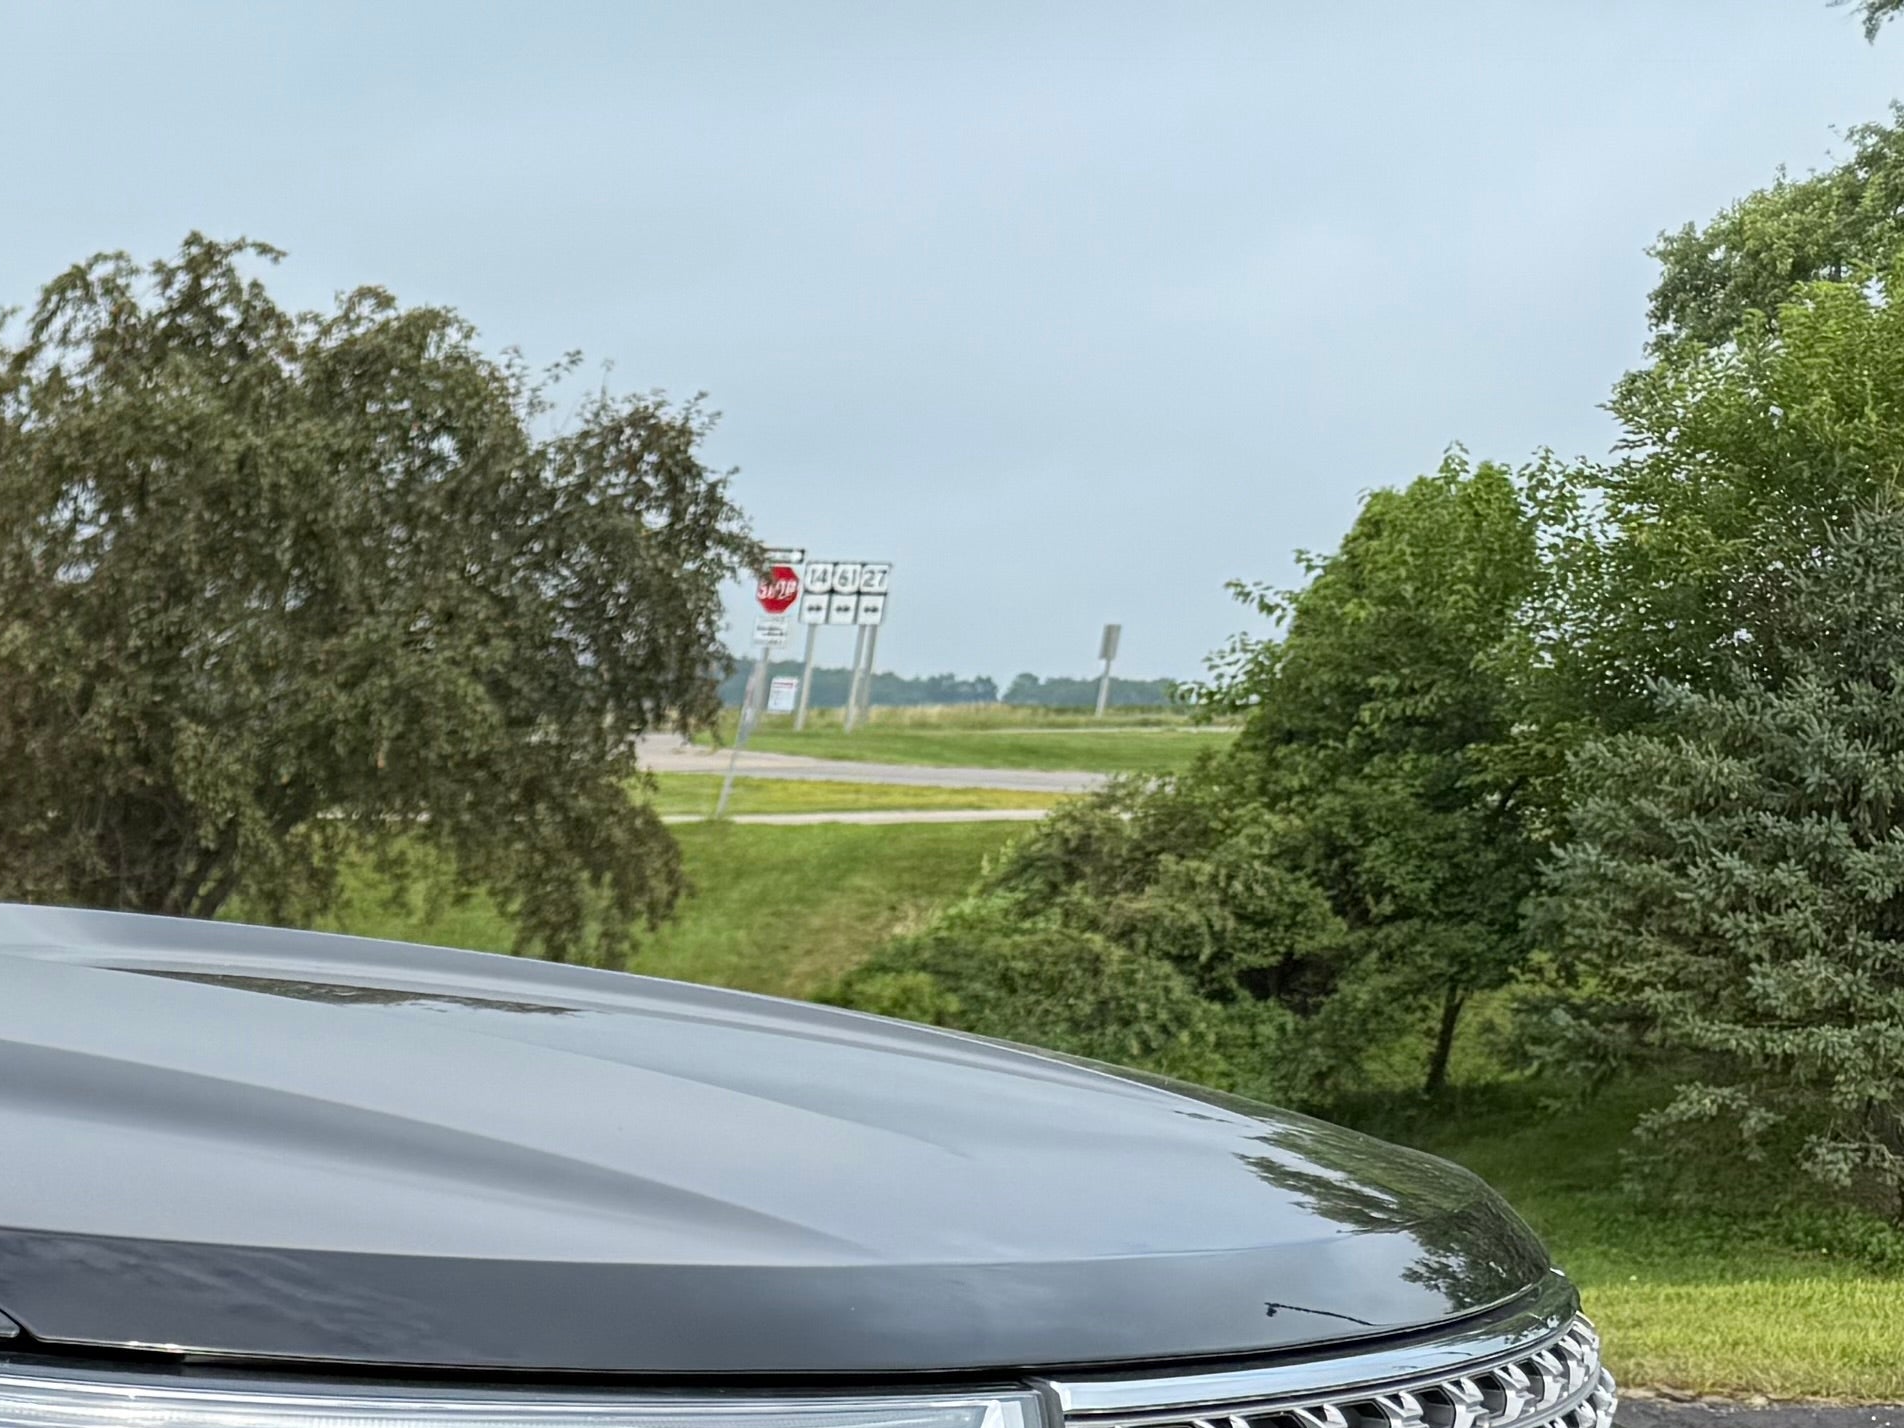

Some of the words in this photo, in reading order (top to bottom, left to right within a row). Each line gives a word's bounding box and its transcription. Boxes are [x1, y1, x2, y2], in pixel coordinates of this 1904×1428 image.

[809, 568, 828, 584] 14
[838, 568, 857, 587] 61
[863, 570, 888, 588] 27
